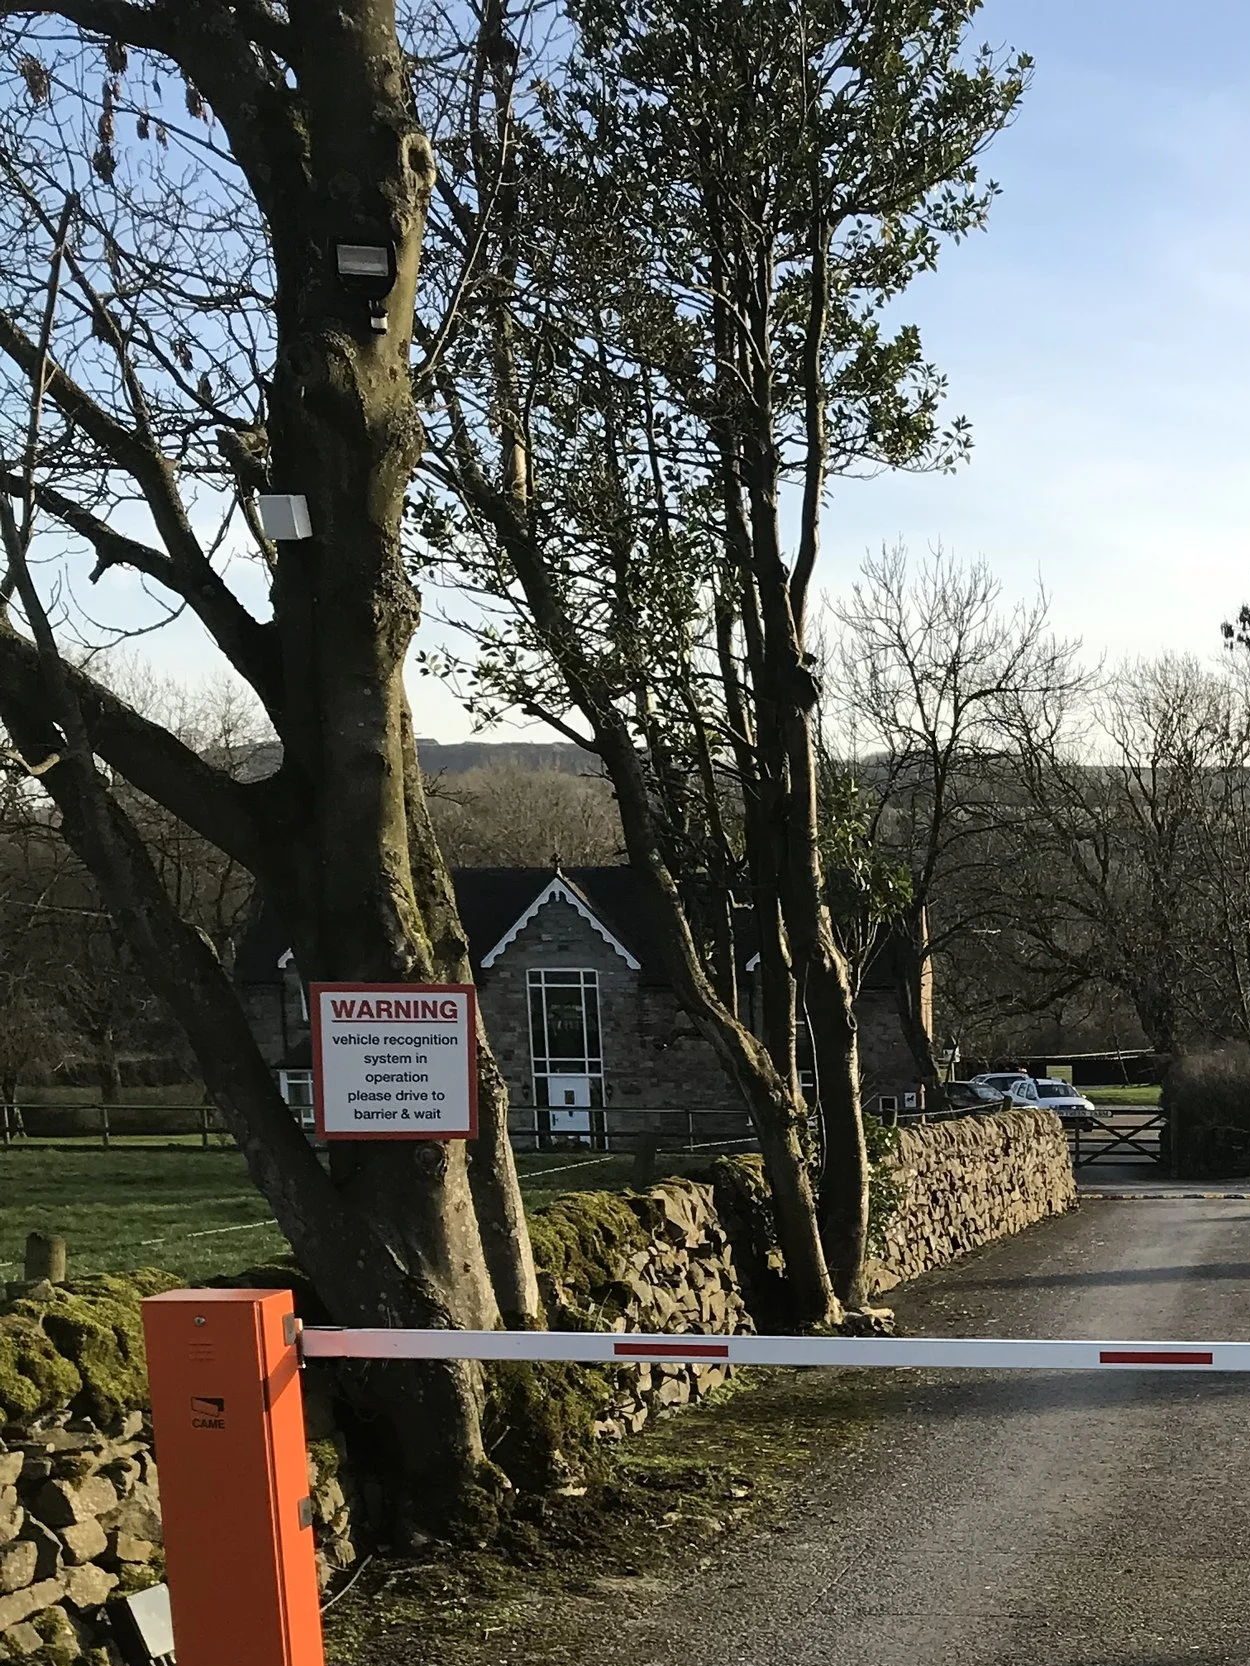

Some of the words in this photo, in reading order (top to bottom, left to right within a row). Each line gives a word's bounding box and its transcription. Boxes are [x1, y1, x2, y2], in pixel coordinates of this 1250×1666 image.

[331, 1000, 458, 1019] WARNING
[332, 1034, 380, 1045] vehicle
[384, 1034, 458, 1047] recognition
[364, 1054, 412, 1066] system
[416, 1053, 427, 1063] in
[365, 1072, 428, 1084] operation
[348, 1090, 391, 1103] please
[396, 1090, 428, 1101] drive
[432, 1092, 445, 1101] to
[354, 1109, 397, 1119] barrier
[401, 1109, 410, 1119] &
[414, 1109, 441, 1119] wait
[192, 1418, 225, 1429] CAME
